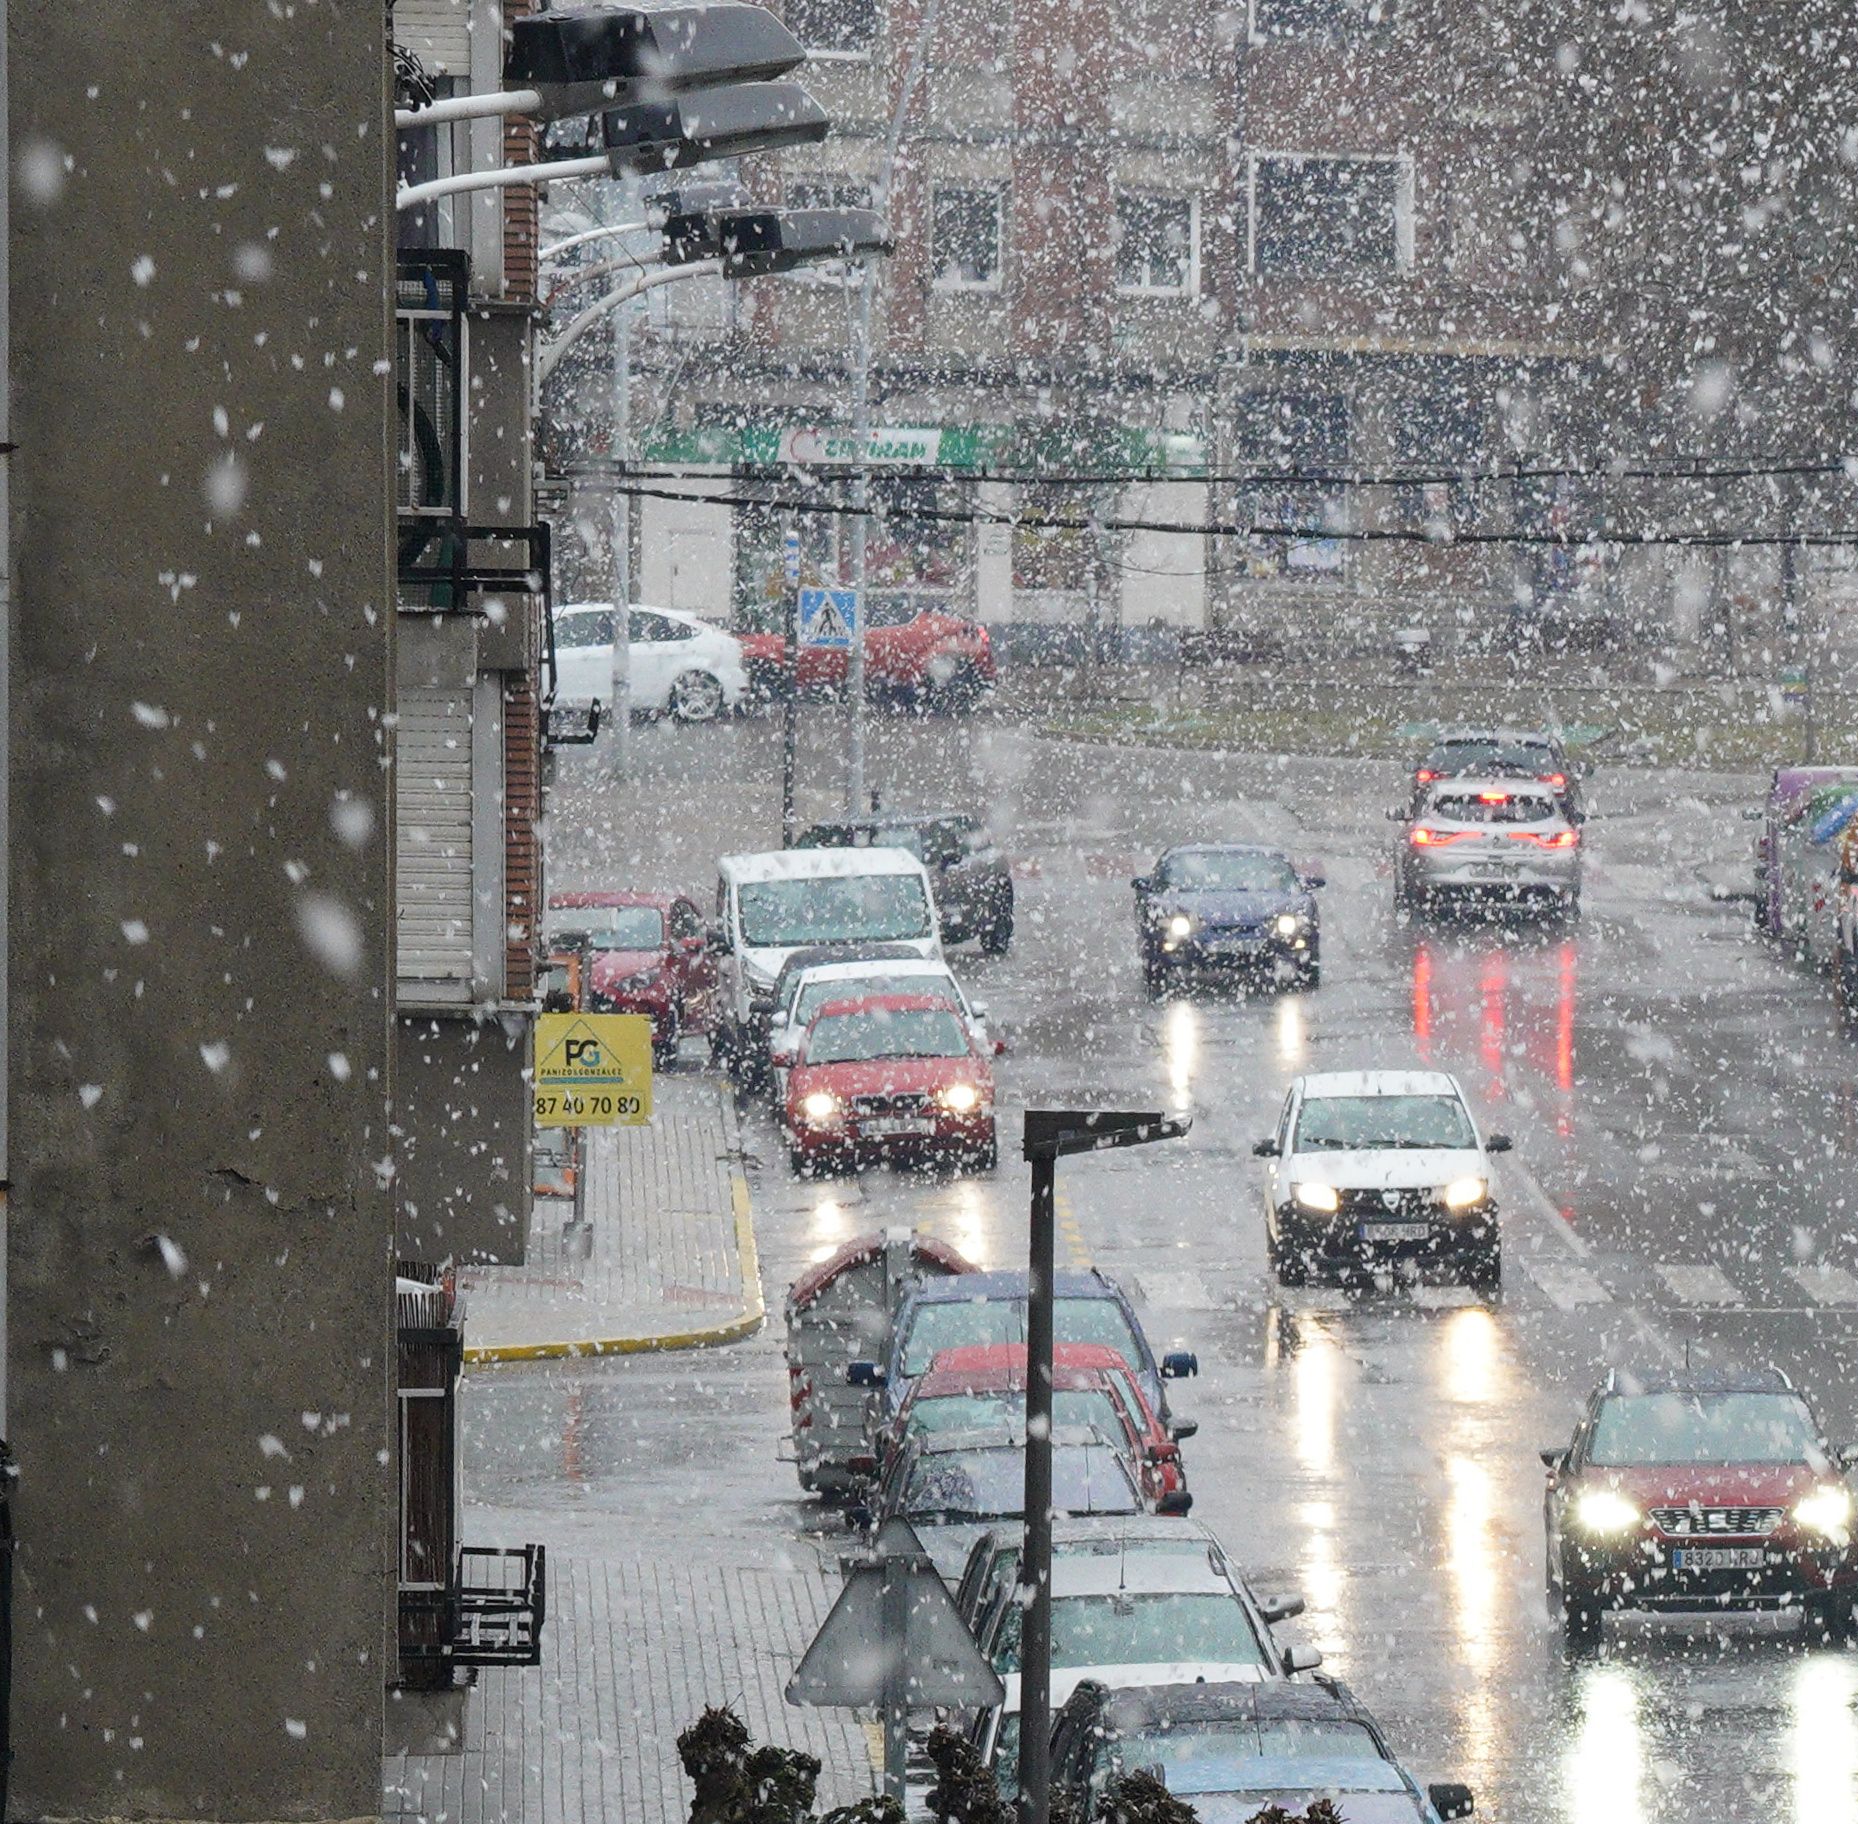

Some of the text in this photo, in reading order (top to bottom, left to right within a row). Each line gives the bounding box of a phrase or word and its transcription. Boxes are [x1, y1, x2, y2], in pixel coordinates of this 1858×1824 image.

[565, 1039, 600, 1067] PG
[563, 1097, 584, 1115] 40
[590, 1097, 612, 1115] 70
[617, 1097, 640, 1114] 80
